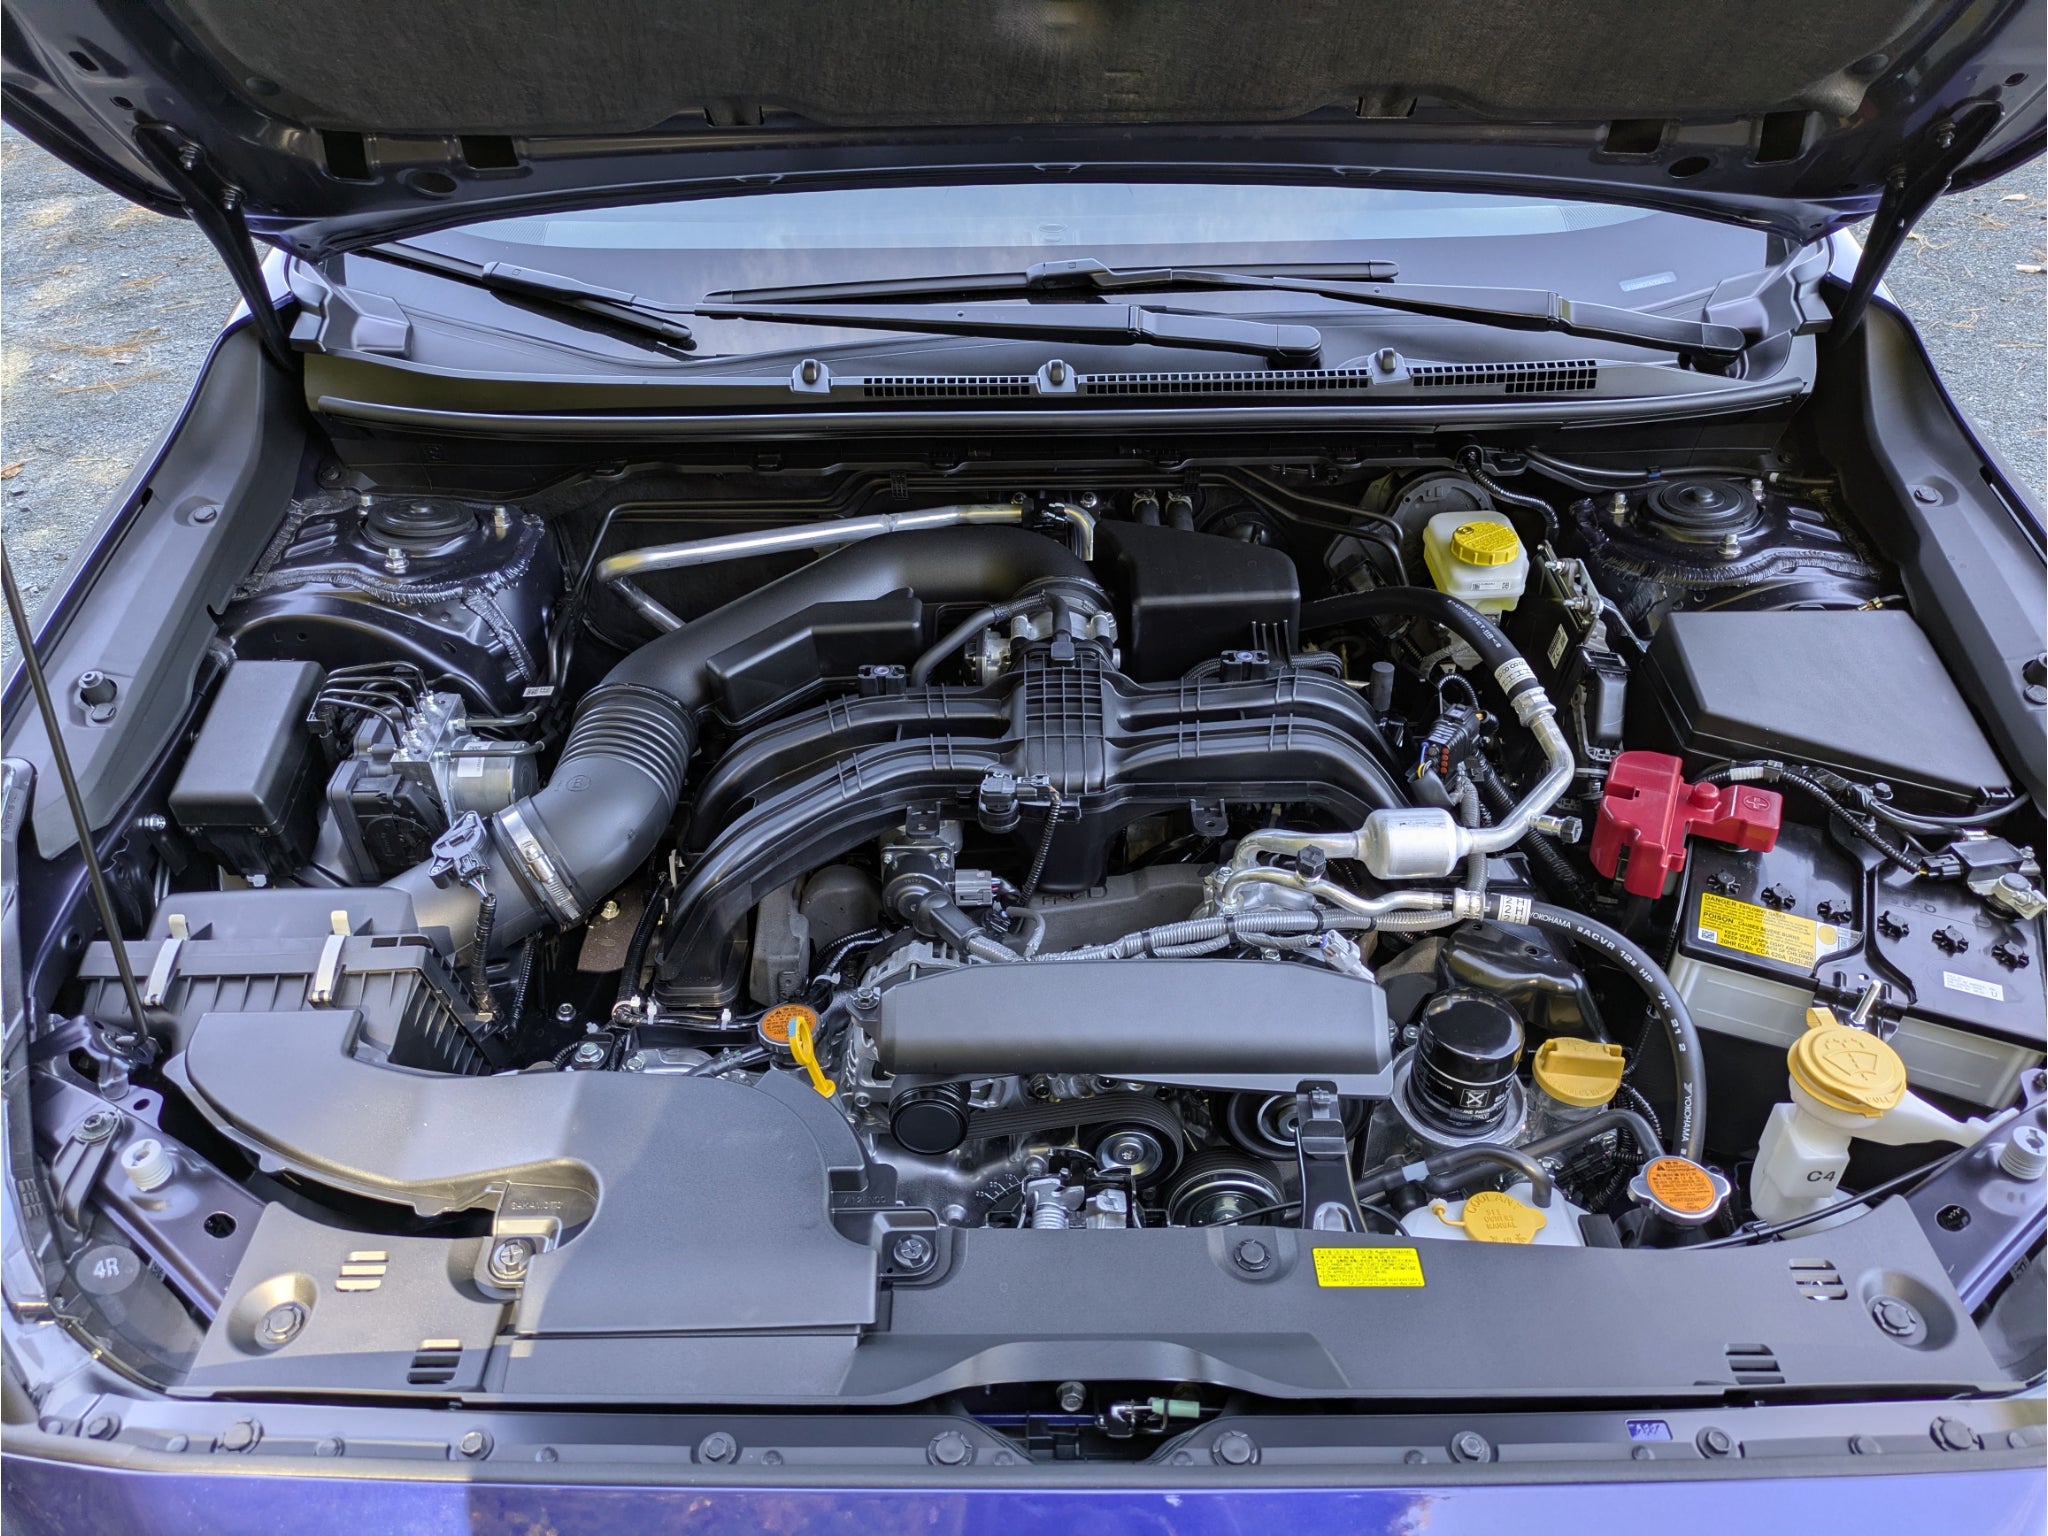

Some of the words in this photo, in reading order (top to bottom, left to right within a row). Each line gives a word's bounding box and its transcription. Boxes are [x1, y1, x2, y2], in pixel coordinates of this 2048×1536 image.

[1704, 894, 1737, 907] DANGER
[1504, 904, 1512, 914] 2
[1515, 906, 1524, 916] H
[1703, 911, 1734, 924] POISON
[1529, 911, 1572, 929] YOKOHAMA
[1639, 968, 1654, 983] HP
[1681, 1095, 1692, 1142] YOKOHAMA
[1806, 1170, 1836, 1182] C4
[1466, 1193, 1524, 1214] COOLANT
[93, 1257, 119, 1279] 4R
